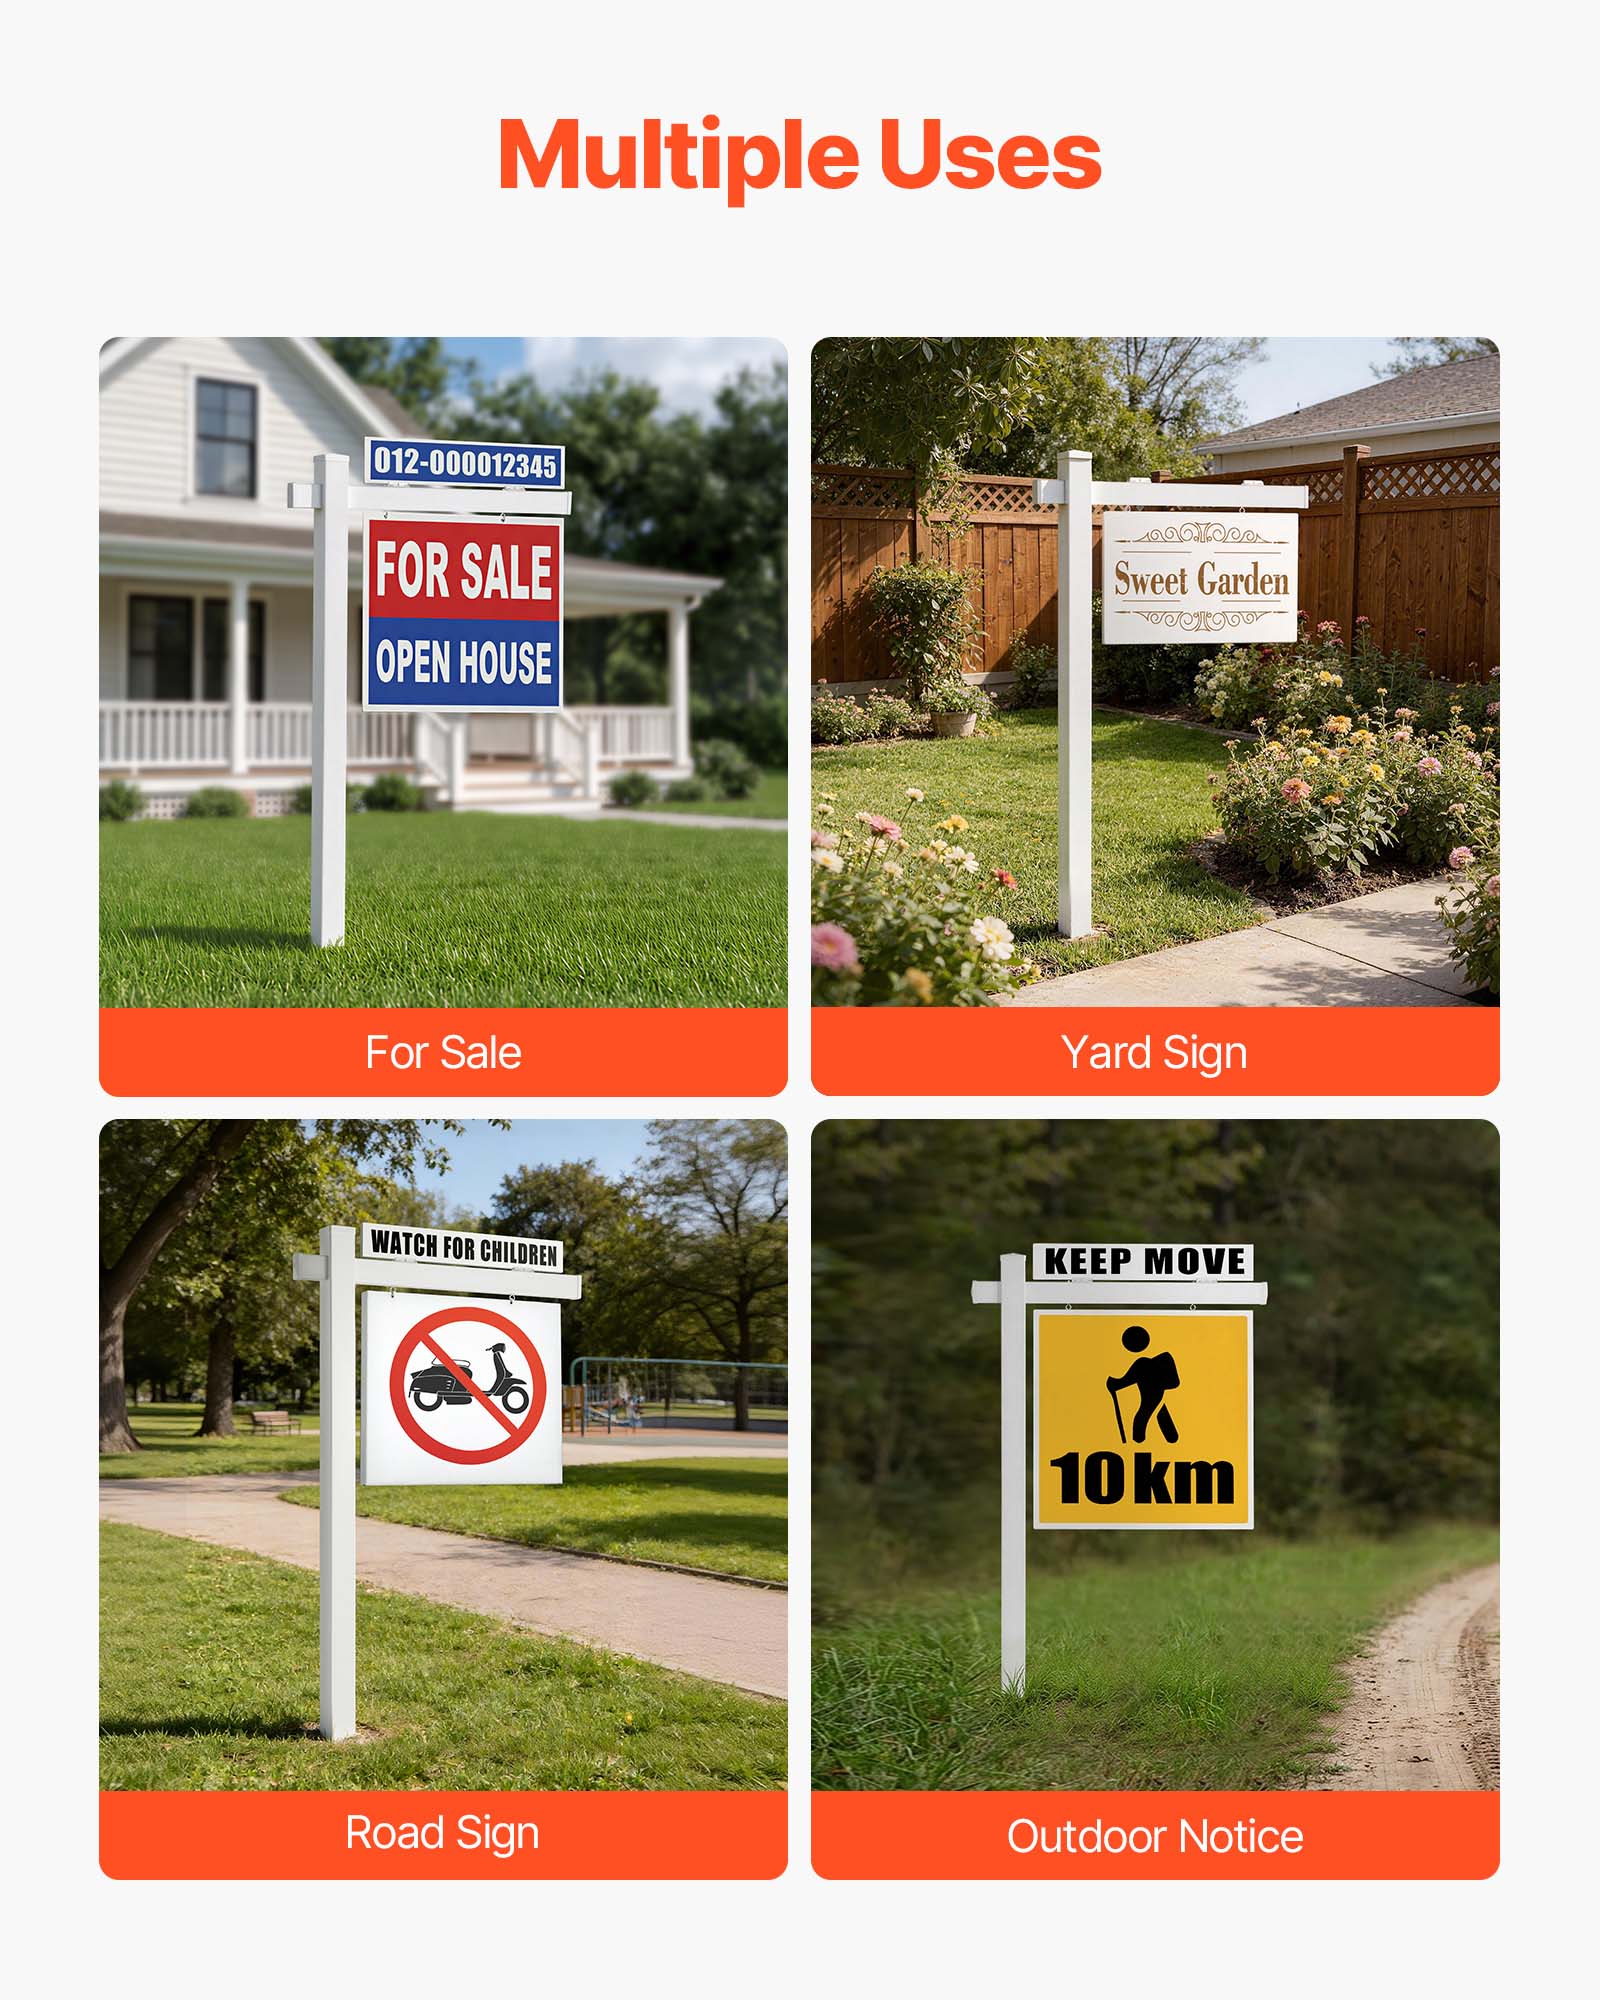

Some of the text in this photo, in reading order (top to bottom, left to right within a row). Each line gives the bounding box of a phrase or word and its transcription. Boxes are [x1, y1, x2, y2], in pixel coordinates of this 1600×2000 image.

[374, 446, 557, 479] 012-000012345
[378, 541, 551, 599] FOR SALE
[1116, 561, 1289, 596] Sweet Garden
[377, 639, 551, 684] OPEN HOUSE
[371, 1229, 558, 1267] WATCH FOR CHILDREN
[1046, 1248, 1244, 1274] KEEP MOVE
